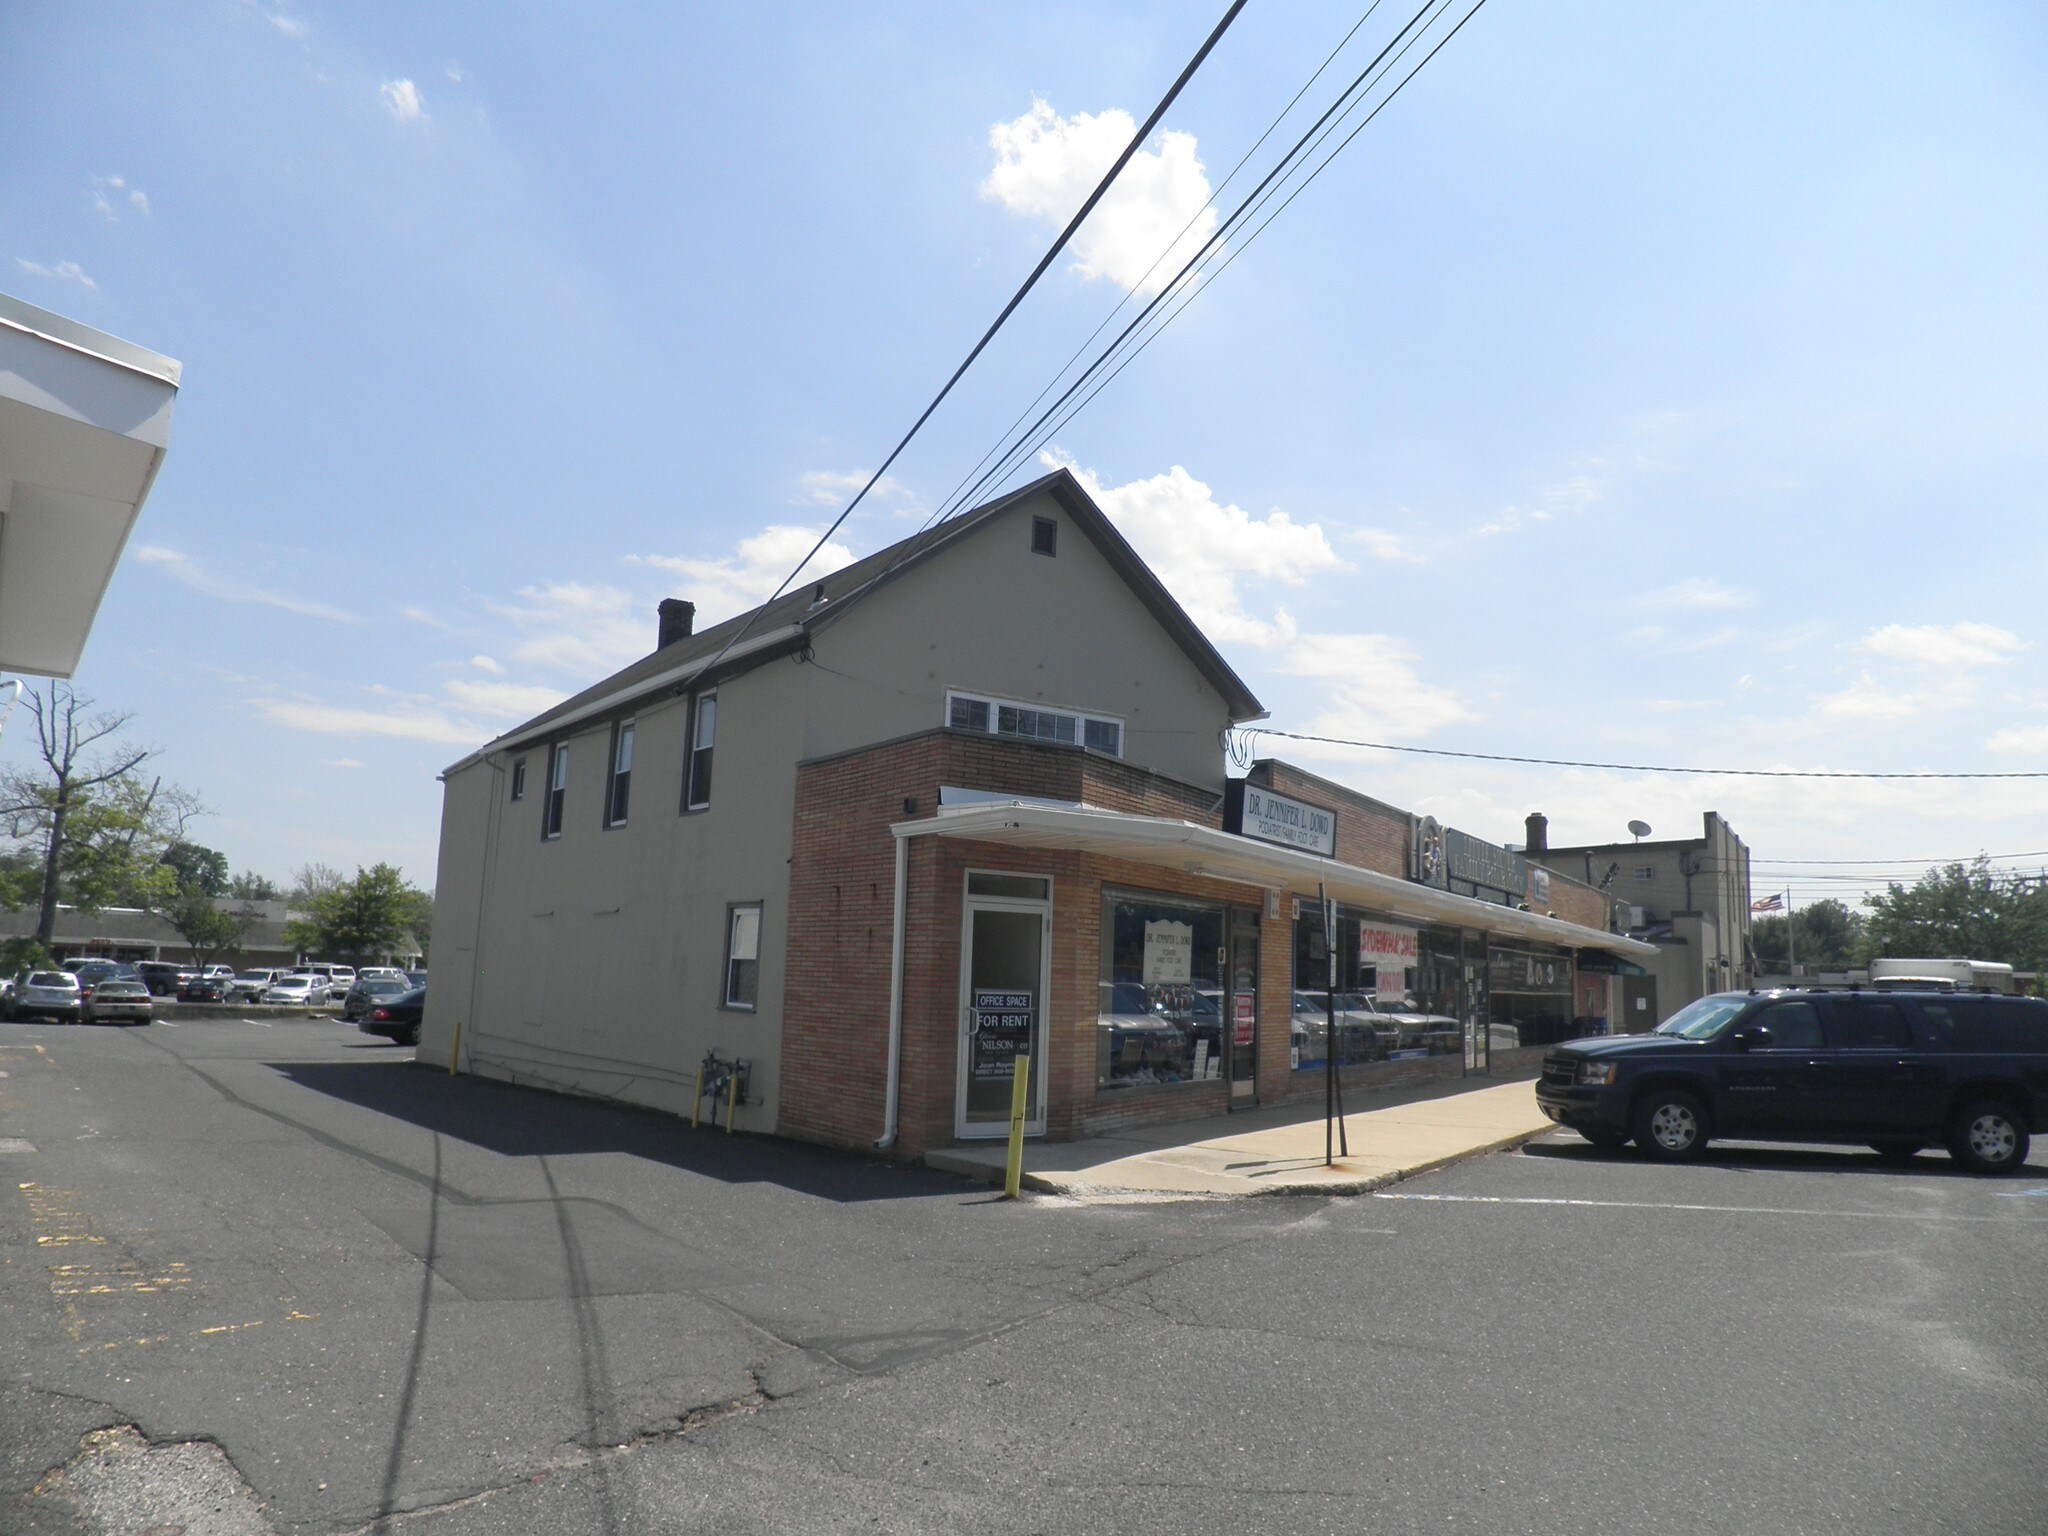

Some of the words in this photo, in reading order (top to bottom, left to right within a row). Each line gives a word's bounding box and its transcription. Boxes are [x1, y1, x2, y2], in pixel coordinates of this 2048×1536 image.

[1249, 793, 1261, 816] DR.
[1265, 799, 1300, 827] JENNIFER
[1301, 810, 1307, 829] L.
[1309, 812, 1329, 835] DOWD
[980, 995, 1004, 1006] OFFICE
[1006, 996, 1027, 1007] SPACE
[978, 1015, 998, 1027] FOR
[1001, 1015, 1029, 1027] RENT
[982, 1040, 1014, 1050] NILSON
